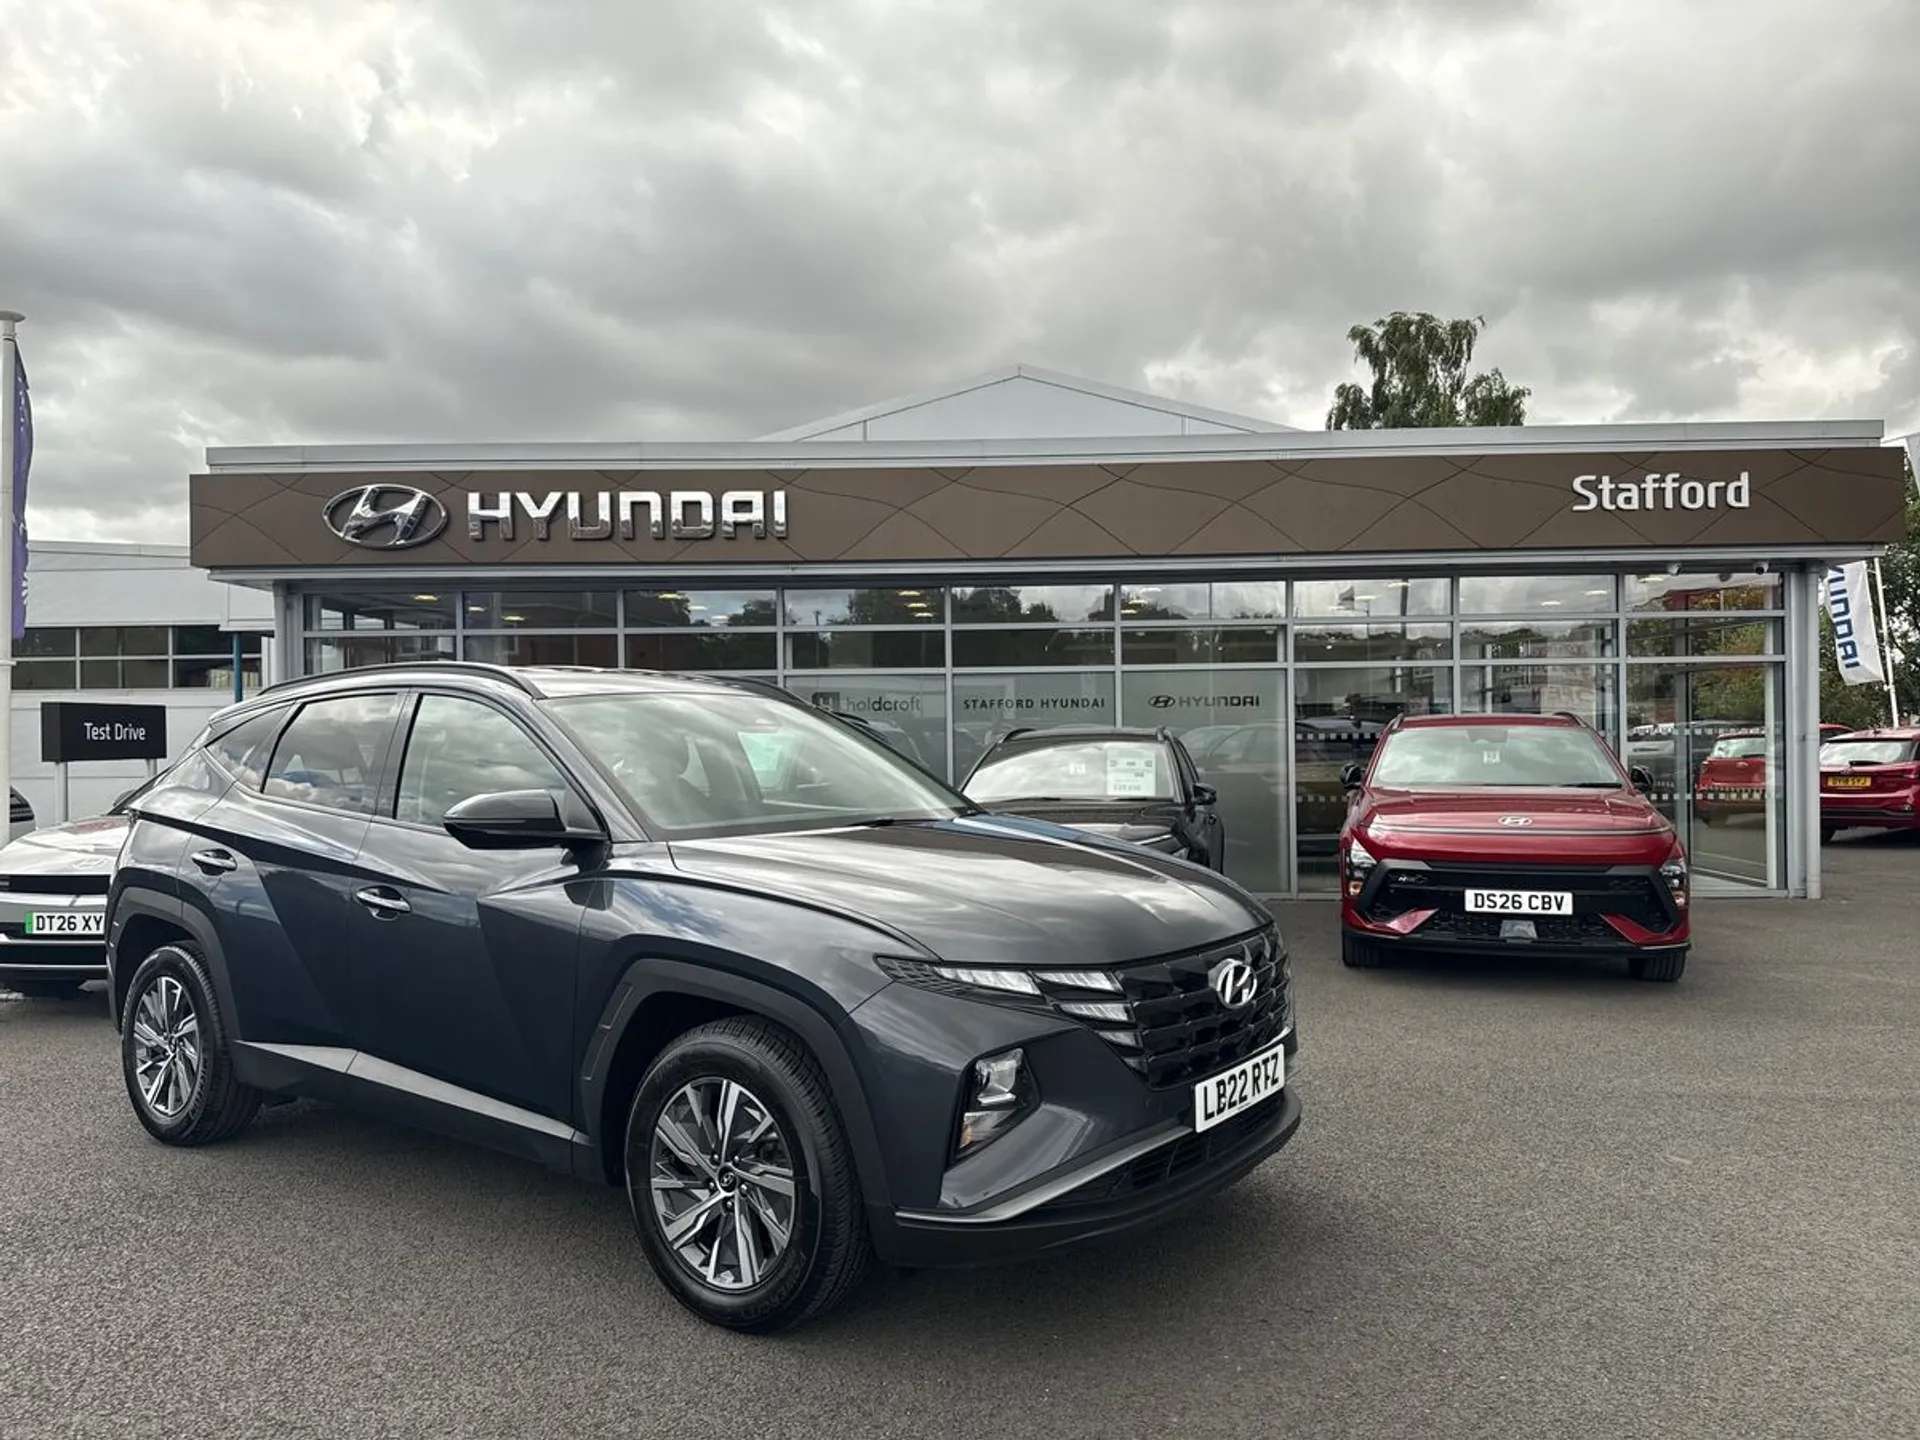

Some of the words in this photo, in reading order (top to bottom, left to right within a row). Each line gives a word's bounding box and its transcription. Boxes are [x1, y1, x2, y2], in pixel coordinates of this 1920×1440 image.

[1571, 471, 1750, 512] Stafford
[467, 489, 788, 541] HYUNDAI
[1828, 566, 1861, 669] UNDAI
[846, 696, 921, 711] holdcroft
[963, 698, 1034, 710] STAFFORD
[1040, 698, 1105, 709] HYUNDAI
[1178, 695, 1260, 707] HYUNDAI
[83, 722, 111, 740] Test
[115, 723, 146, 740] Drive
[1473, 892, 1523, 910] DS26
[1528, 894, 1565, 911] CBV
[36, 915, 77, 931] DT26
[82, 915, 104, 931] XY
[1203, 1068, 1248, 1121] LB22
[1251, 1051, 1280, 1097] RTZ
